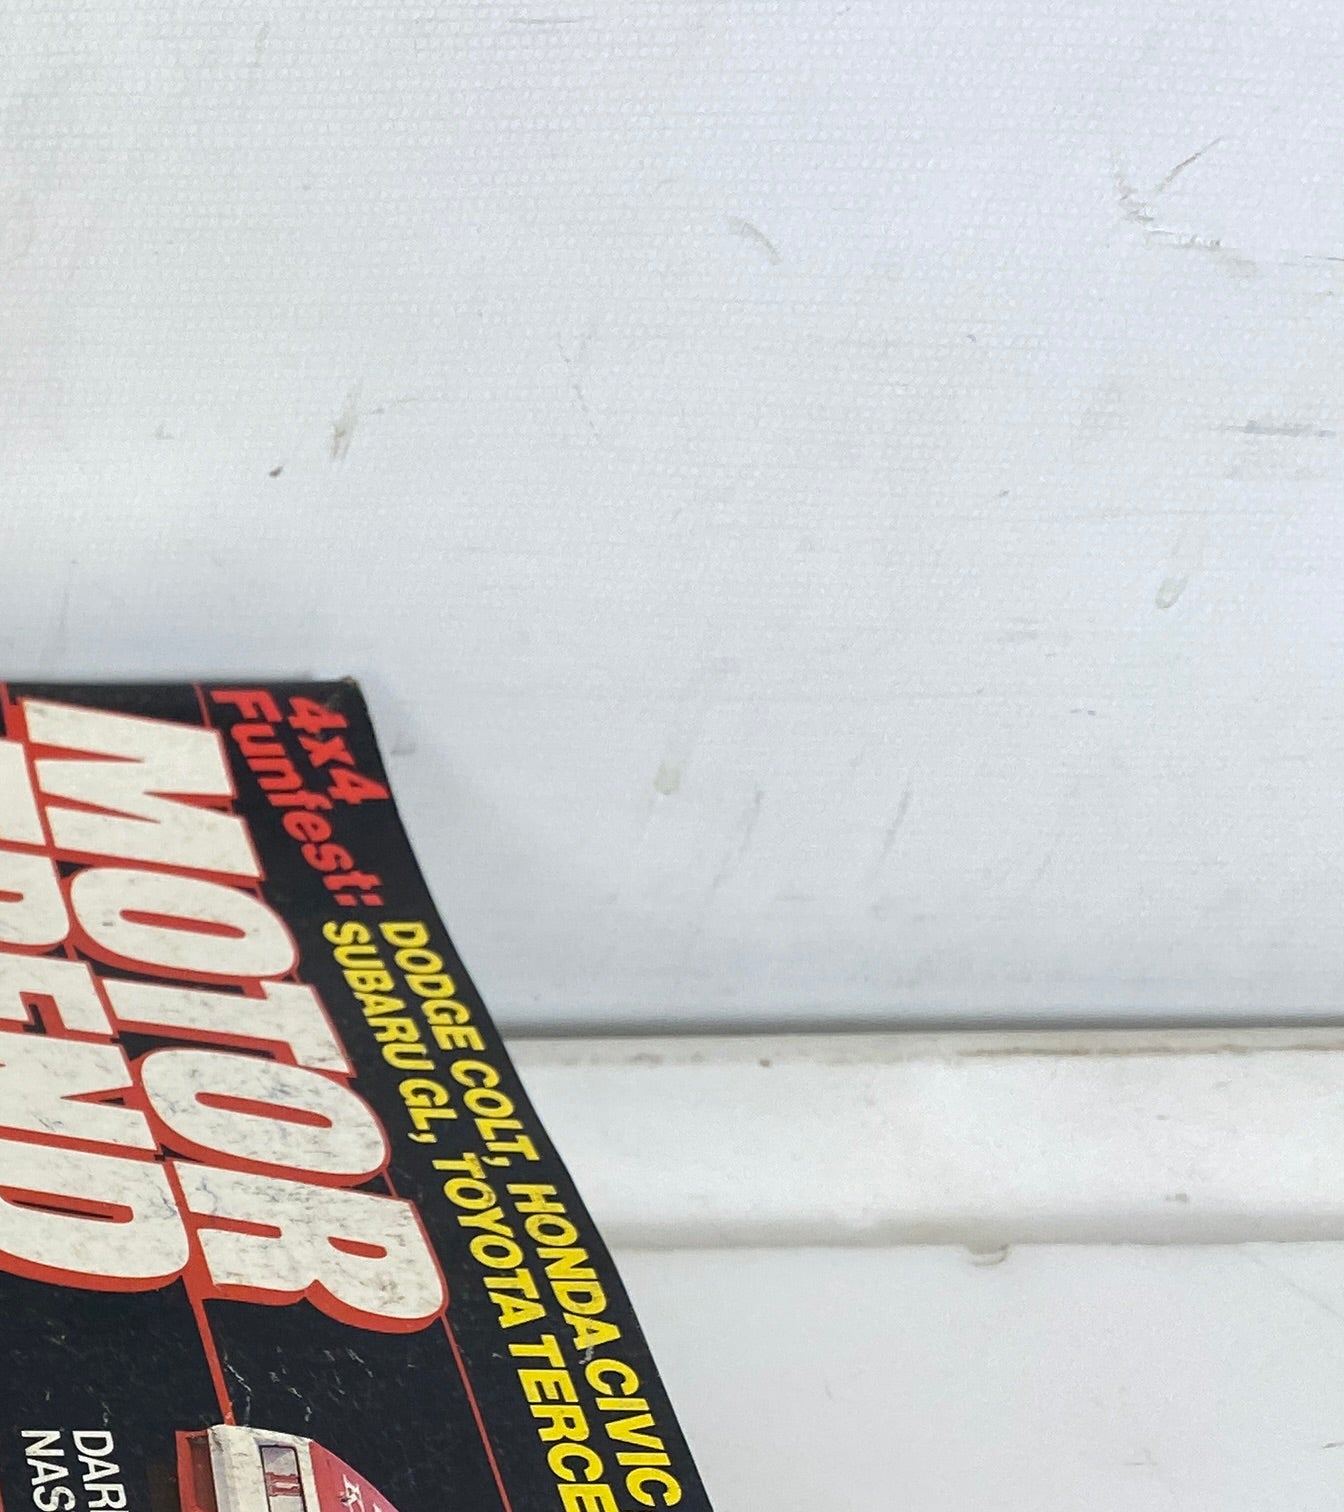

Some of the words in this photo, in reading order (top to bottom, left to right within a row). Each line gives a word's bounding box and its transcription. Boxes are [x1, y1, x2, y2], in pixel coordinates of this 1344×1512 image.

[212, 689, 384, 908] Funfest:
[285, 696, 390, 807] 4x4
[16, 697, 445, 1320] MOTOR
[322, 920, 435, 1071] SUBARU
[398, 1078, 458, 1144] GL,
[432, 1153, 547, 1328] TOYOTA
[379, 920, 486, 1052] DODGE
[450, 1060, 541, 1167] COLT,
[507, 1184, 623, 1350] HONDA
